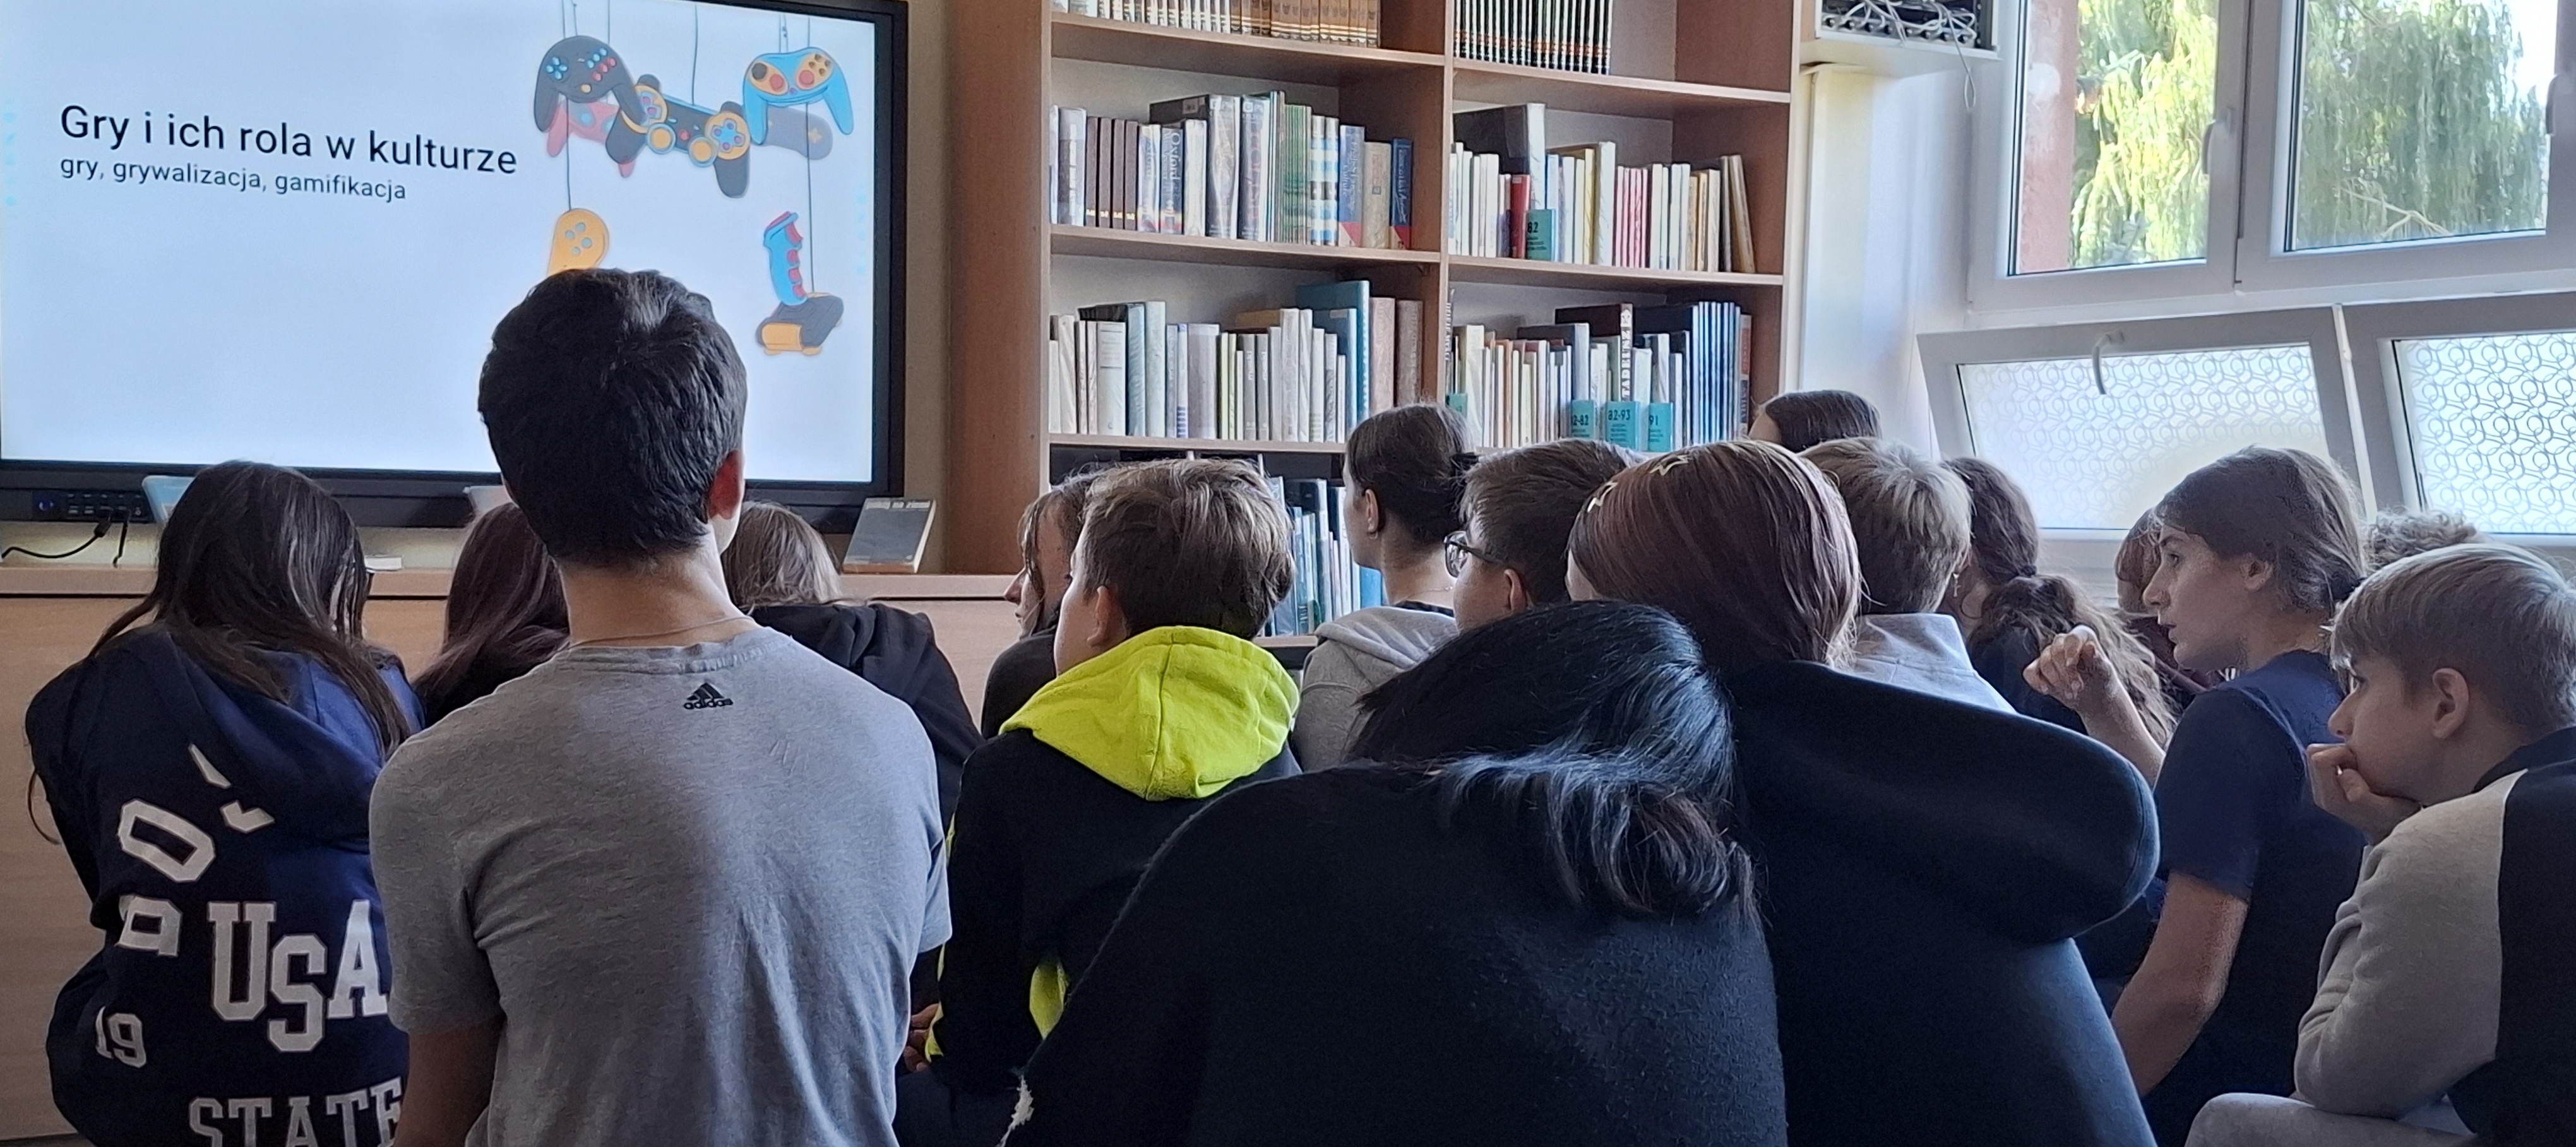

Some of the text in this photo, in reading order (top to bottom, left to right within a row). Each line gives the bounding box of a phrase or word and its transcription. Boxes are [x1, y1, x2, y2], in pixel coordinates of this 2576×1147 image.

[61, 105, 517, 175] Gry i ich rola w kulturze
[1170, 132, 1181, 180] Oxford
[61, 159, 405, 203] gry, grywalizacja, gamifikacja
[1571, 414, 1589, 426] 2-82
[206, 899, 389, 1053] USA
[95, 1005, 147, 1069] 19
